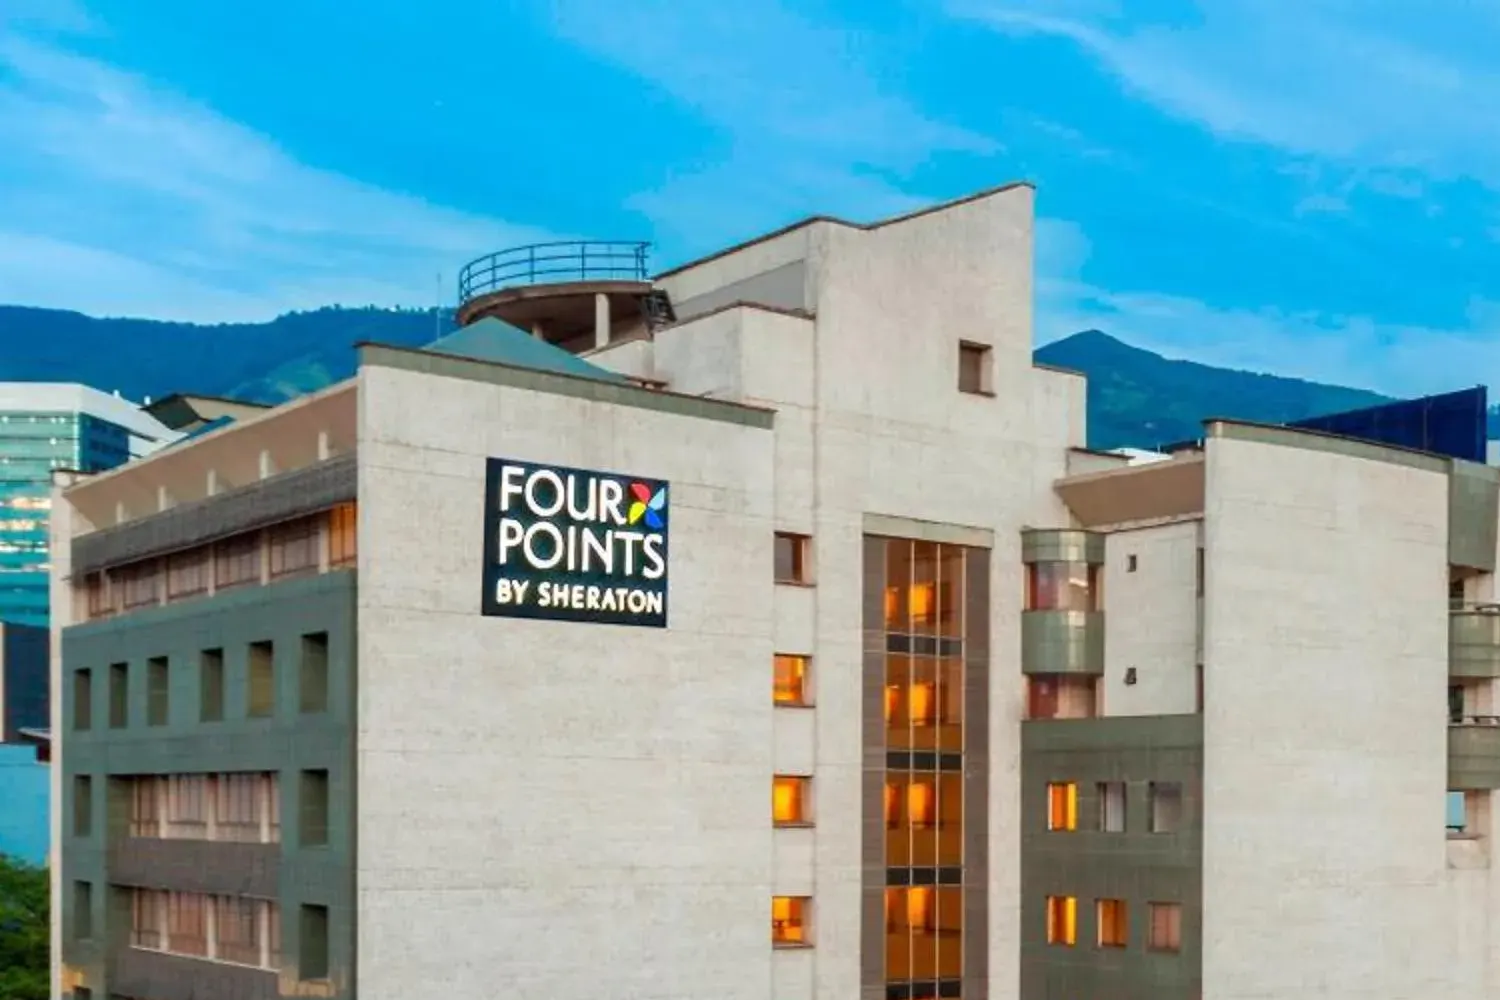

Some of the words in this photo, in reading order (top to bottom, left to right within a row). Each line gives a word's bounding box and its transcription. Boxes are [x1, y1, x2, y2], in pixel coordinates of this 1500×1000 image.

[500, 465, 627, 525] FOUR
[498, 518, 665, 579] POINTS
[496, 578, 529, 605] BY
[537, 581, 663, 614] SHERATON
